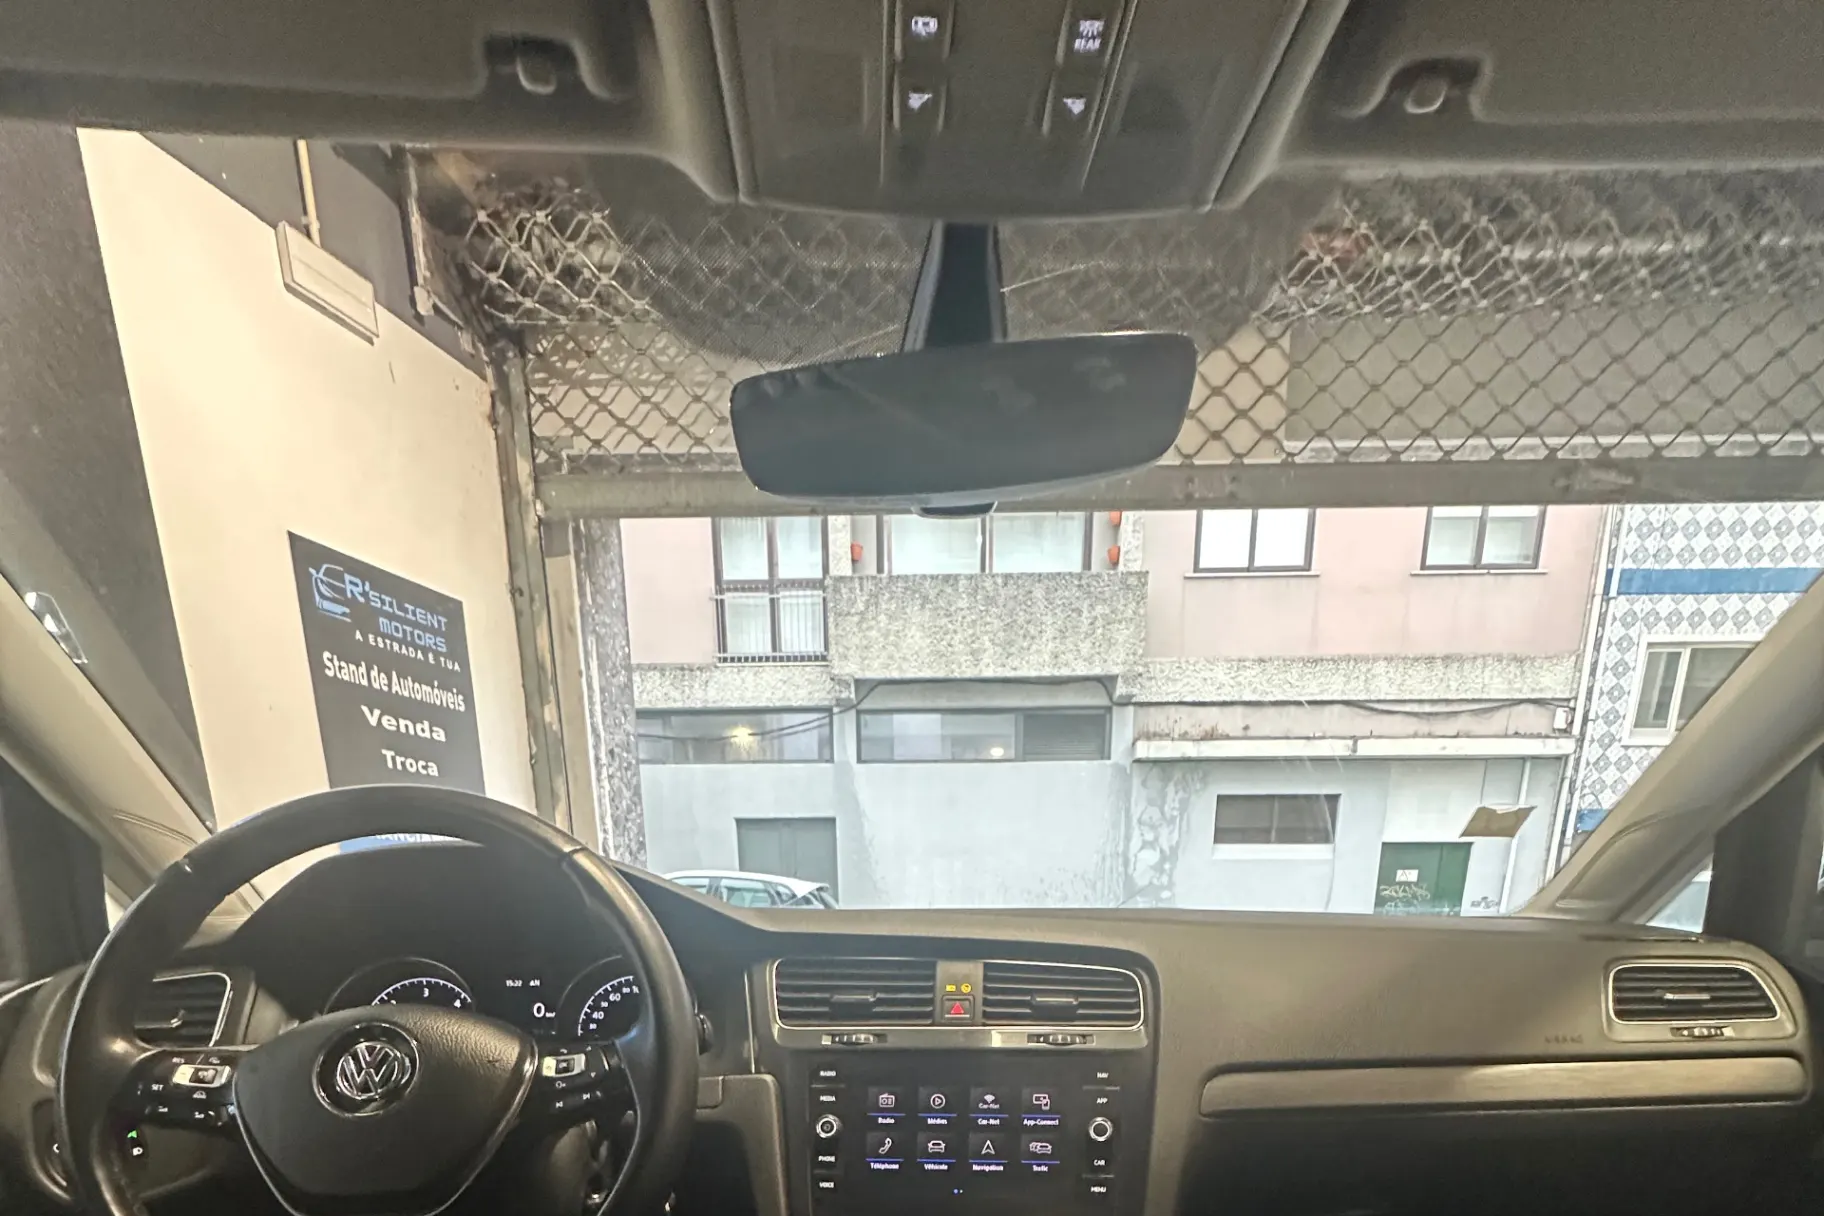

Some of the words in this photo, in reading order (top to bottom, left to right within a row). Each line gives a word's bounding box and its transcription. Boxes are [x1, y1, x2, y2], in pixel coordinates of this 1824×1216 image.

[379, 617, 447, 653] MOTORS
[355, 630, 364, 642] A
[368, 634, 425, 661] ESTRADA
[440, 657, 461, 673] TUA
[322, 650, 369, 687] Stand
[370, 664, 389, 692] de
[391, 670, 466, 712] Automóveis
[360, 704, 447, 742] Venda
[381, 748, 439, 777] Troca
[423, 987, 430, 998] 3
[609, 992, 621, 1002] 60
[533, 1002, 545, 1018] 0
[592, 1011, 604, 1020] 40
[151, 1083, 164, 1091] SET
